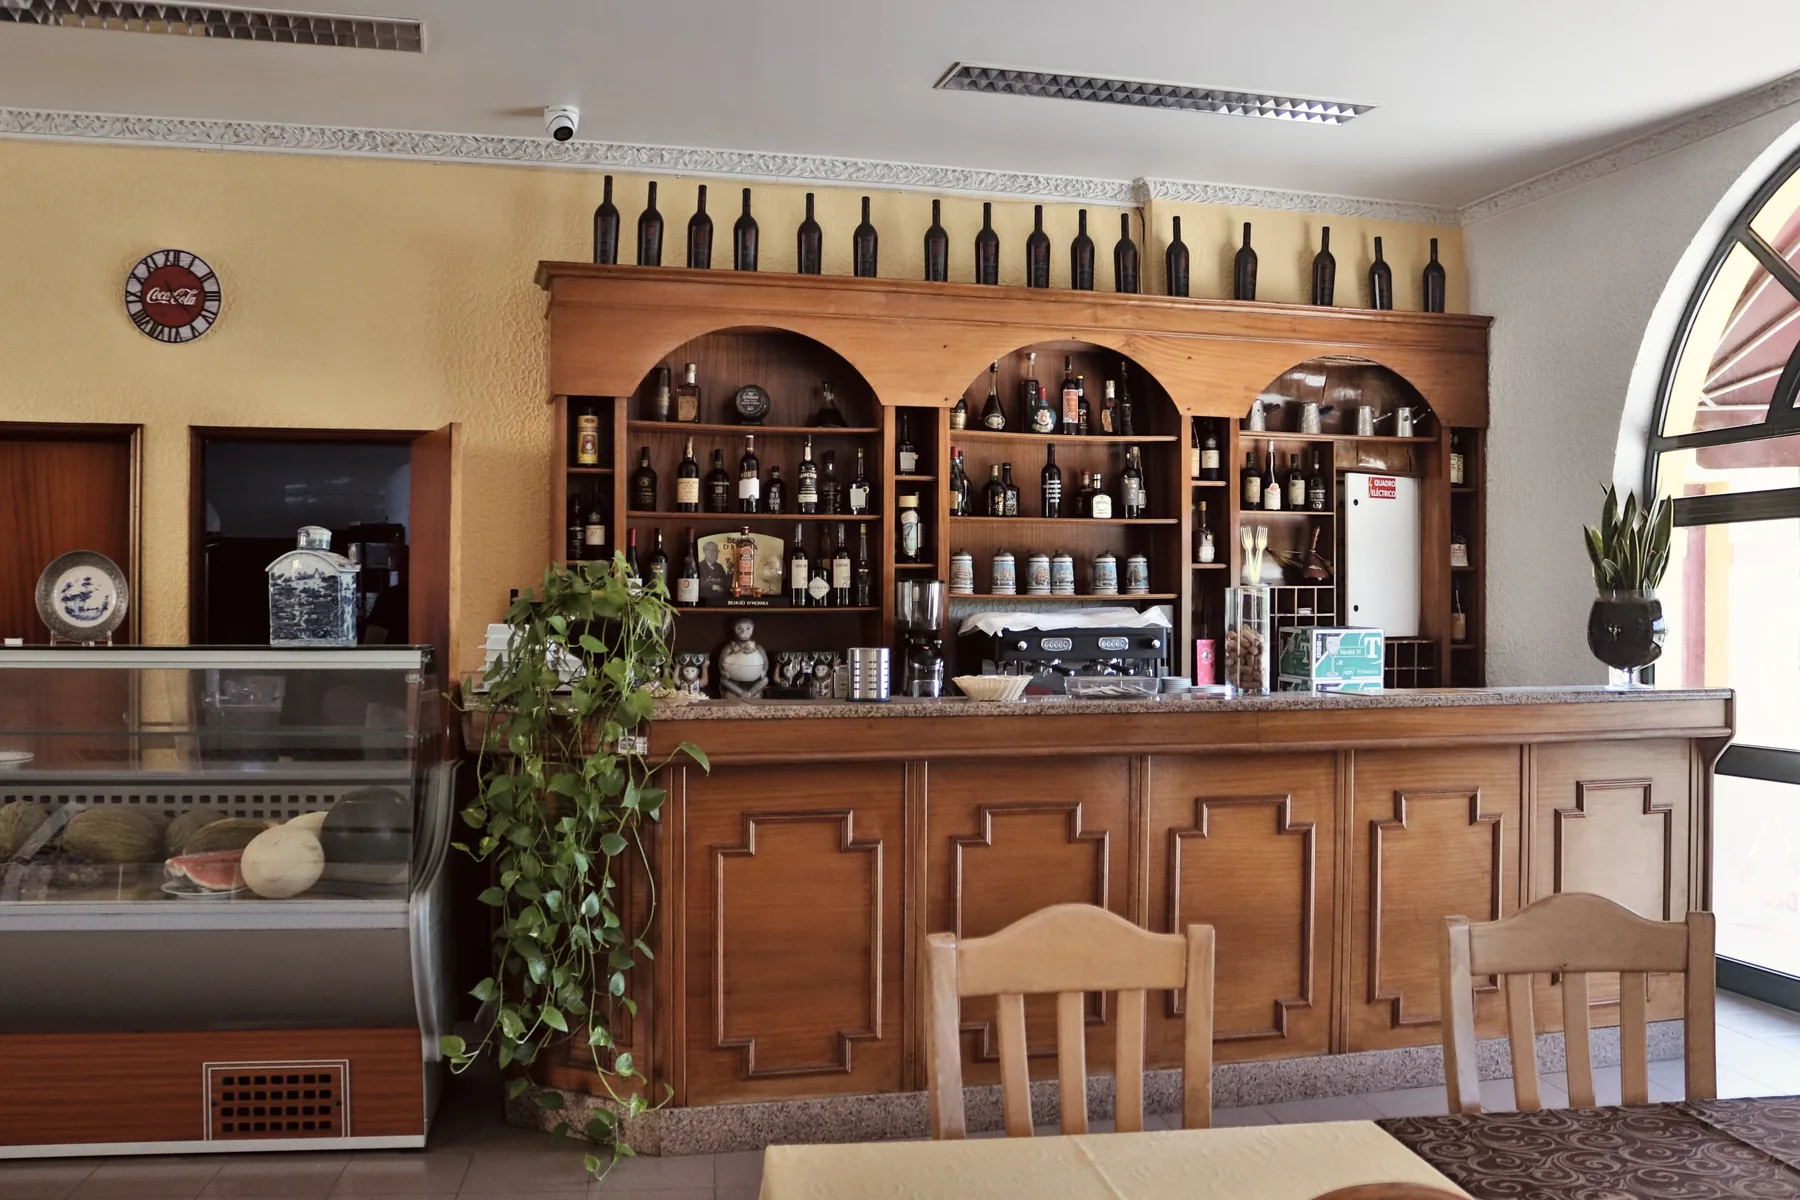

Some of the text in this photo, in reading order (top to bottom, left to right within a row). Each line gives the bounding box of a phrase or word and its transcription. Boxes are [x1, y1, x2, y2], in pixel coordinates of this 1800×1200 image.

[1374, 479, 1396, 487] QUADRO
[1371, 488, 1396, 498] ELÉCTRICO
[1364, 637, 1381, 658] T
